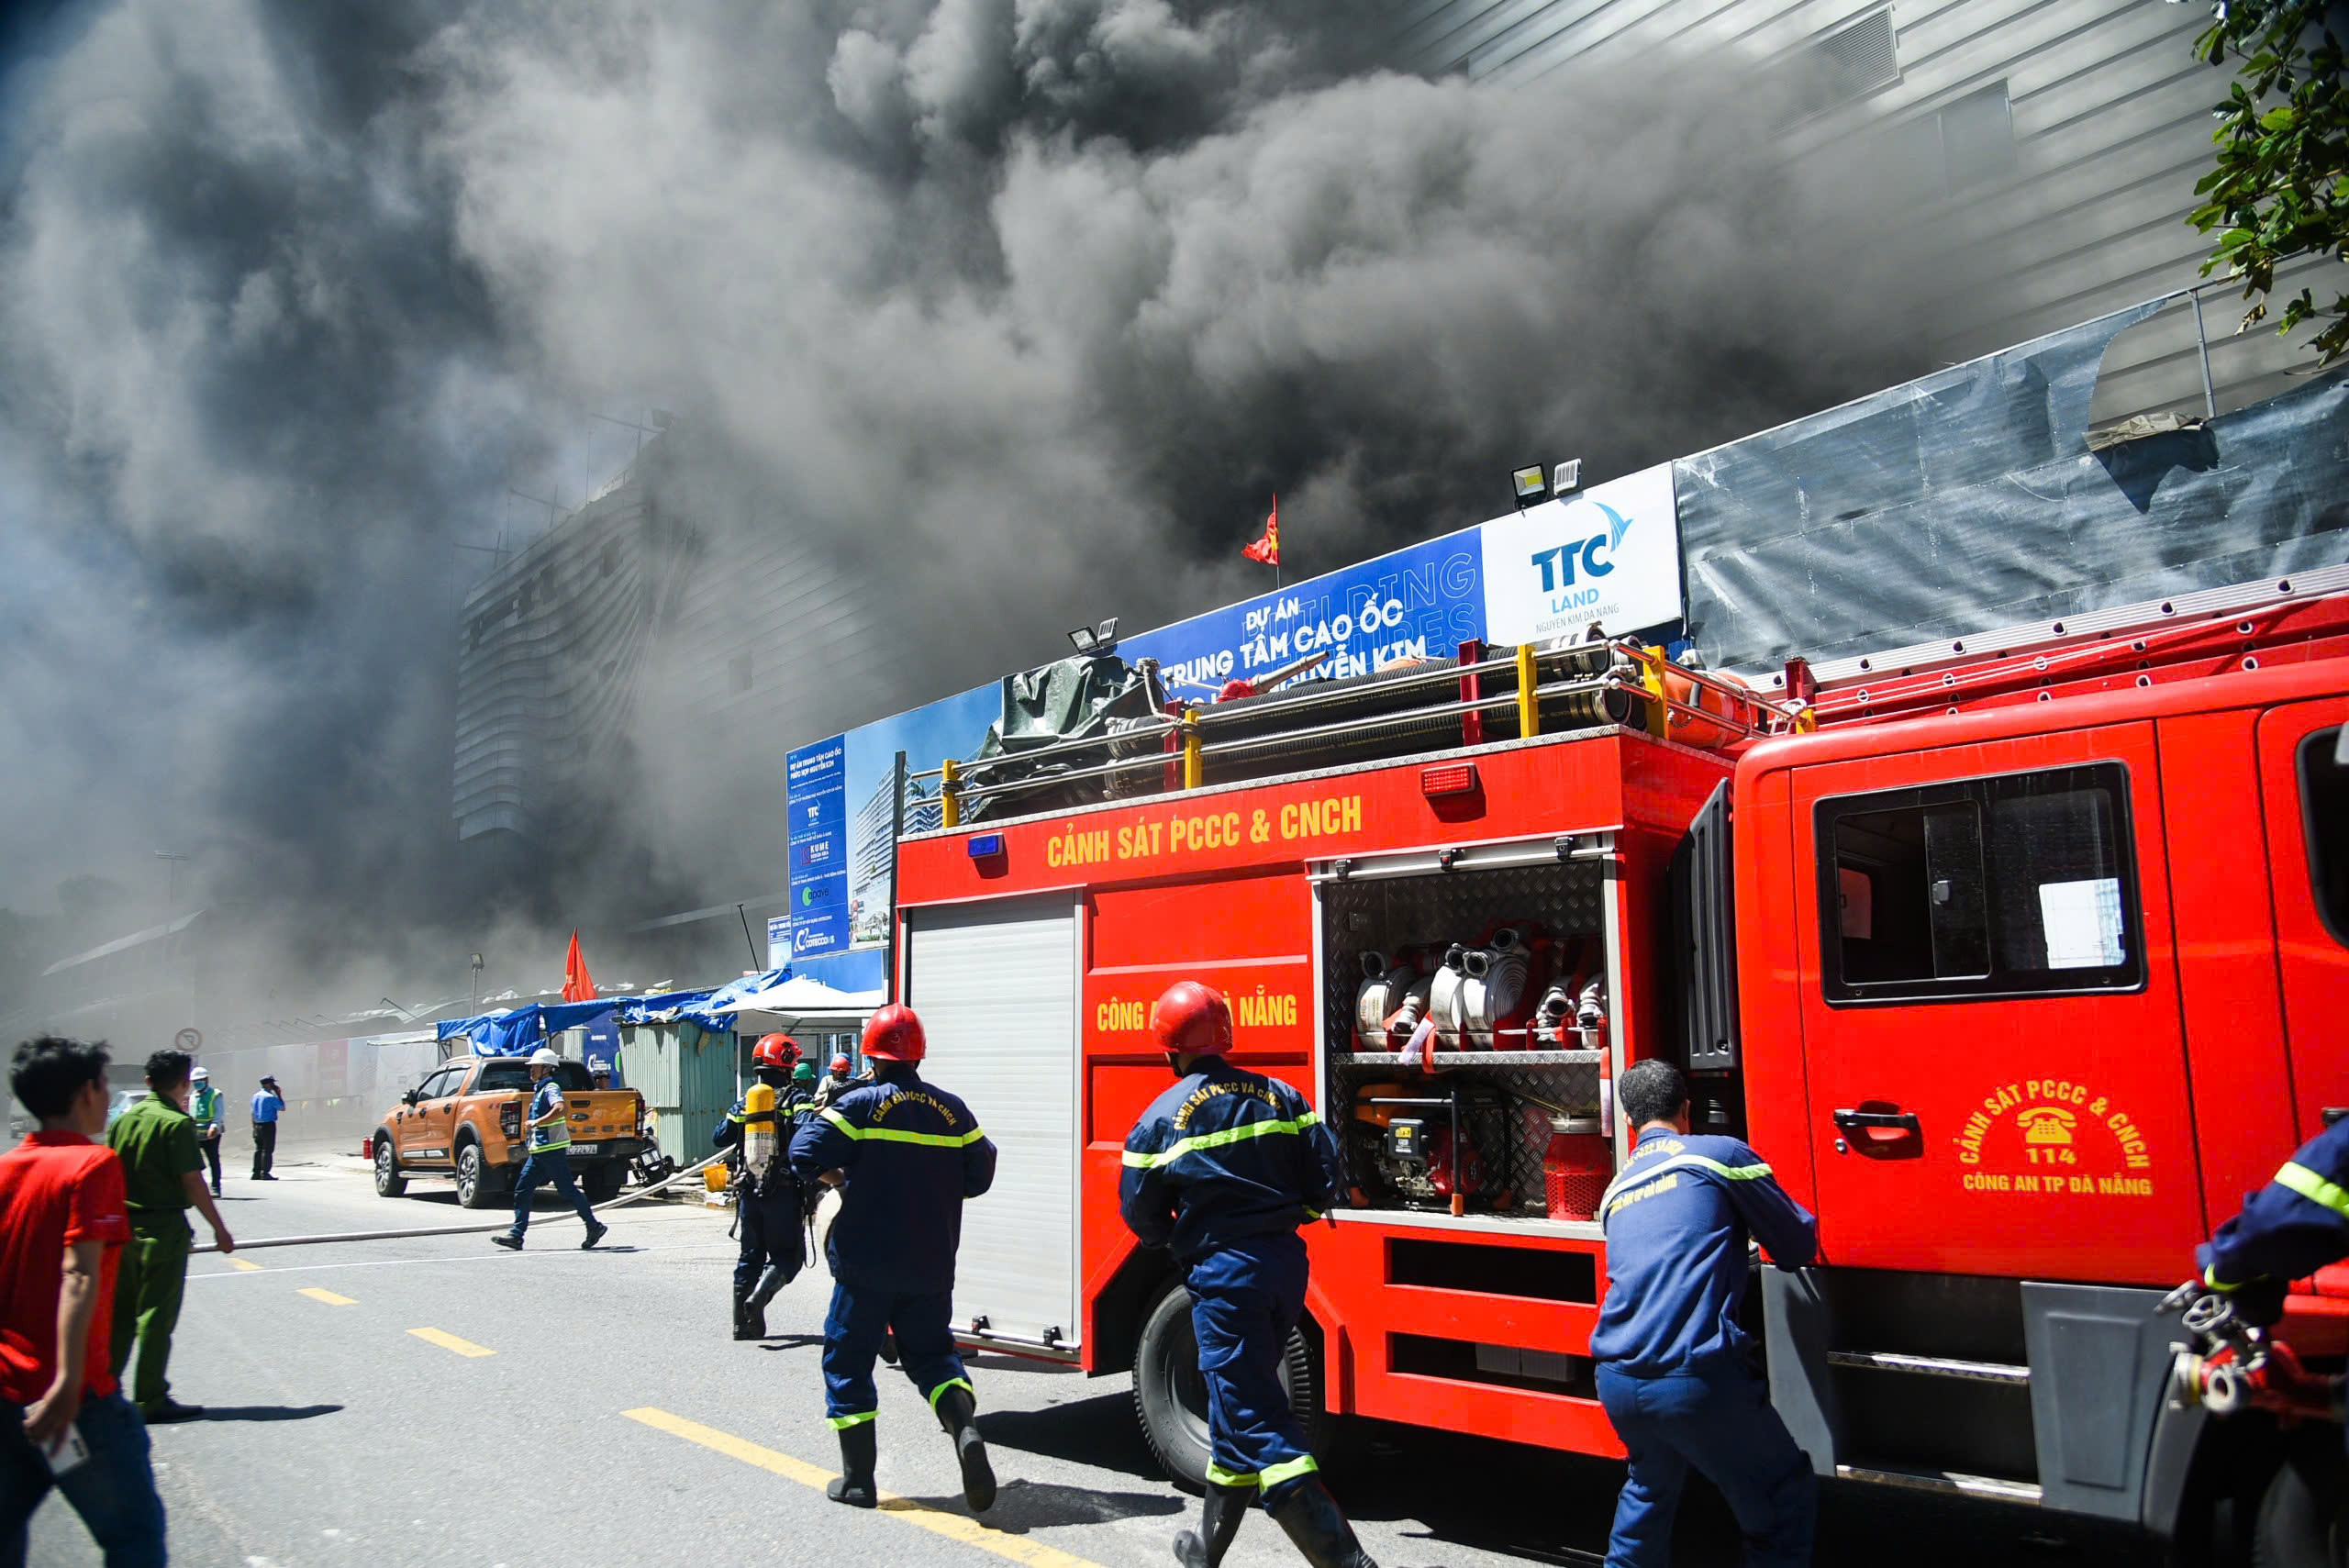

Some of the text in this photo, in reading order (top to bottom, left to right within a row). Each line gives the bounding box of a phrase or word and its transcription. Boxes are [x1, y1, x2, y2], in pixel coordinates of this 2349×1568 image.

[1531, 533, 1615, 593] TTC
[1246, 597, 1299, 632] DỰ ÁN
[1536, 616, 1566, 633] NGUYEN
[1567, 612, 1583, 625] KIM
[1597, 602, 1620, 617] NANG
[1552, 588, 1599, 614] LAND
[1160, 593, 1404, 691] TRUNG TÂM CAO ỐC
[810, 840, 829, 853] KUME
[1048, 795, 1362, 867] CẢNH SÁT PCCC & CNCH
[808, 887, 829, 900] apave
[1097, 996, 1144, 1031] CÔNG
[1240, 984, 1297, 1027] NẴNG
[1953, 1079, 2151, 1168] CẢNH SÁT PCCC & CNCH
[2025, 1148, 2076, 1165] 114
[1963, 1172, 2154, 1196] CÔNG AN TP ĐÀ NẴNG
